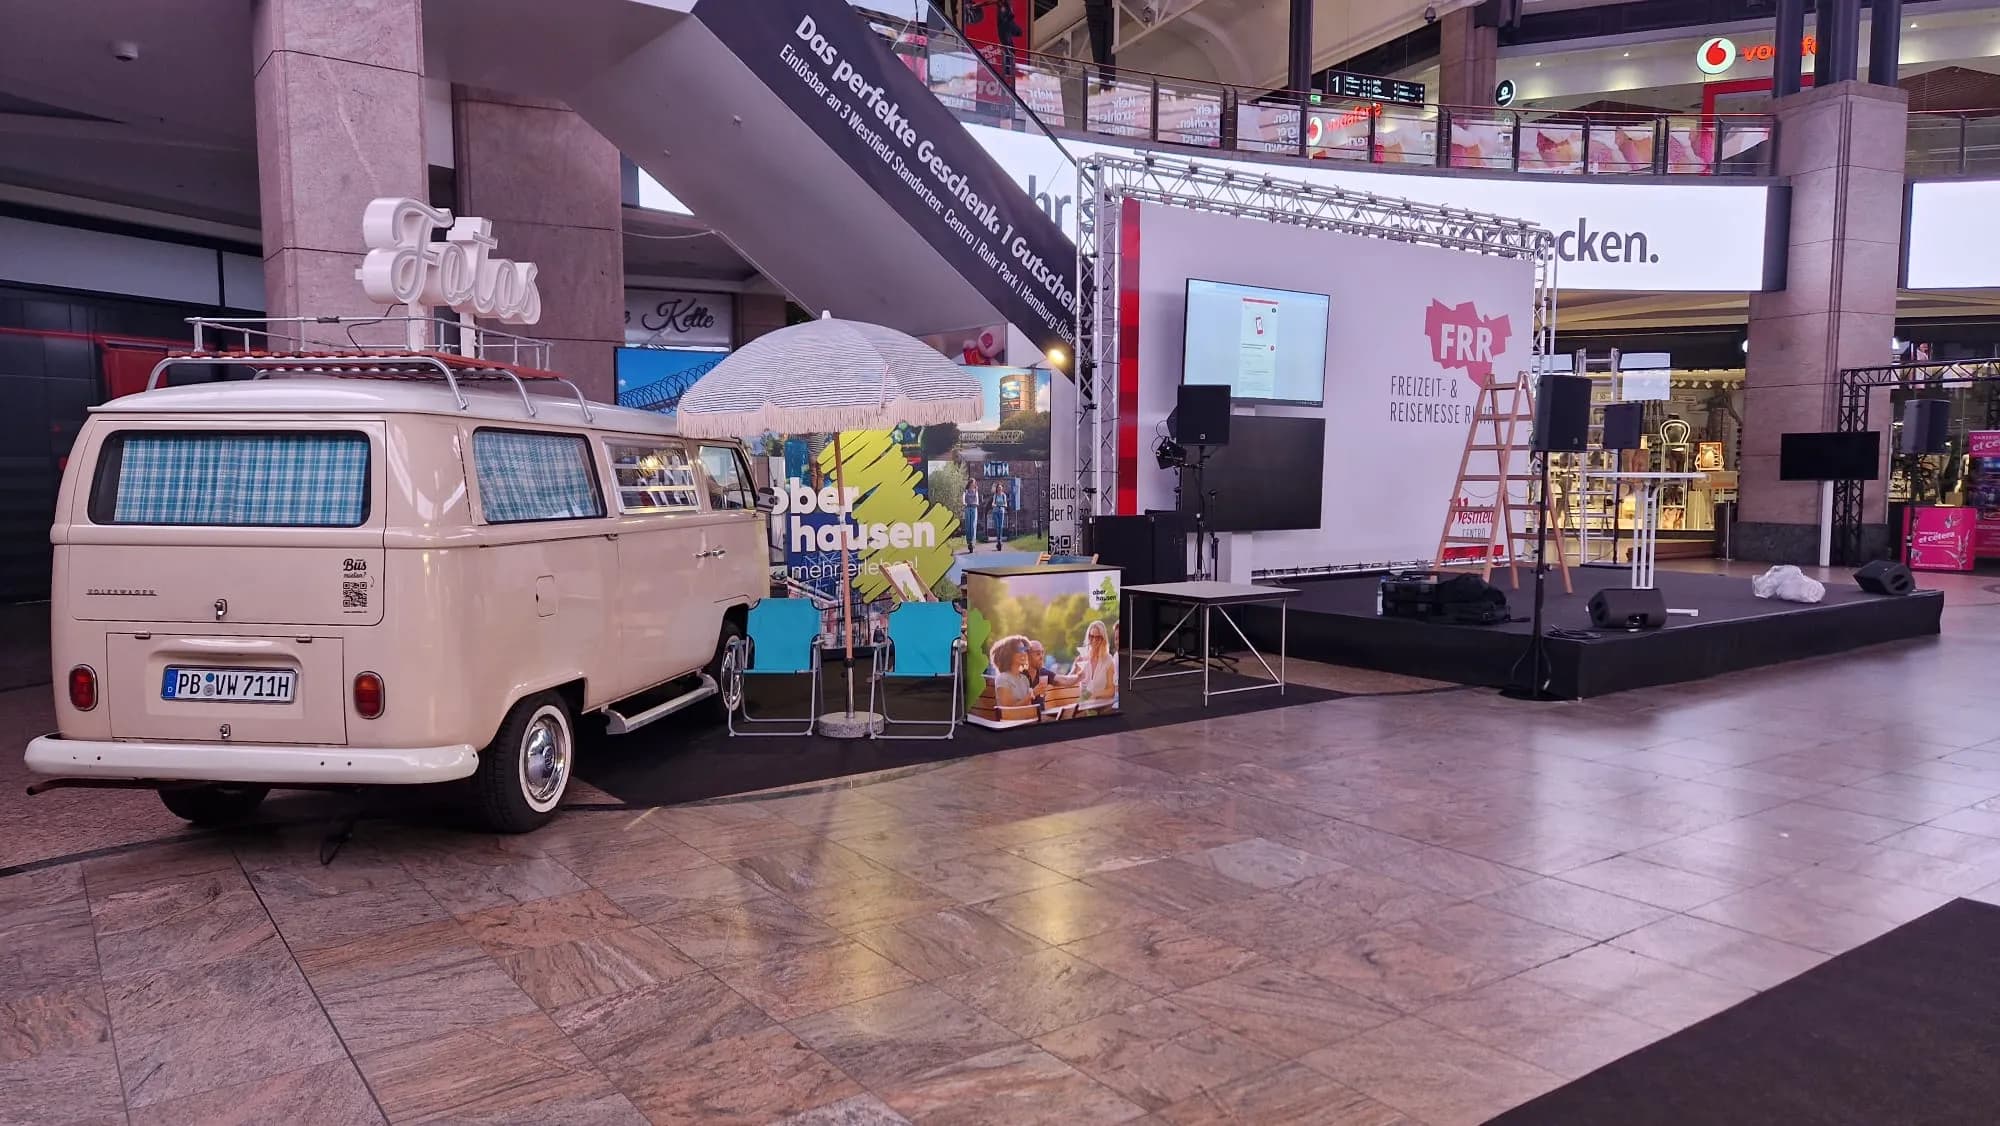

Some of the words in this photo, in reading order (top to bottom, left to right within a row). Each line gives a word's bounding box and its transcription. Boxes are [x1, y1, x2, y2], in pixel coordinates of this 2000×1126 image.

[1332, 75, 1340, 94] 1
[795, 15, 838, 66] Das
[831, 59, 917, 148] perfekte
[1000, 223, 1014, 246] 1
[779, 43, 830, 98] Einlösbar
[826, 93, 842, 112] an
[839, 104, 852, 120] 3
[848, 111, 896, 164] Westfield
[891, 155, 945, 215] Standorten:
[943, 208, 975, 246] Centro
[977, 241, 1001, 270] Ruhr
[997, 261, 1020, 289] Park
[362, 197, 542, 325] Fotos
[1440, 322, 1494, 363] FRR
[1390, 375, 1447, 398] FREIZEIT-
[1450, 378, 1458, 399] &
[1389, 401, 1461, 424] REISEMESSE
[790, 515, 936, 553] hausen
[343, 558, 367, 572] Bus
[791, 560, 842, 580] mehr
[86, 588, 156, 596] VOLKSWAGEN
[177, 672, 201, 695] PB
[214, 673, 239, 697] VW
[242, 674, 291, 699] 711H
